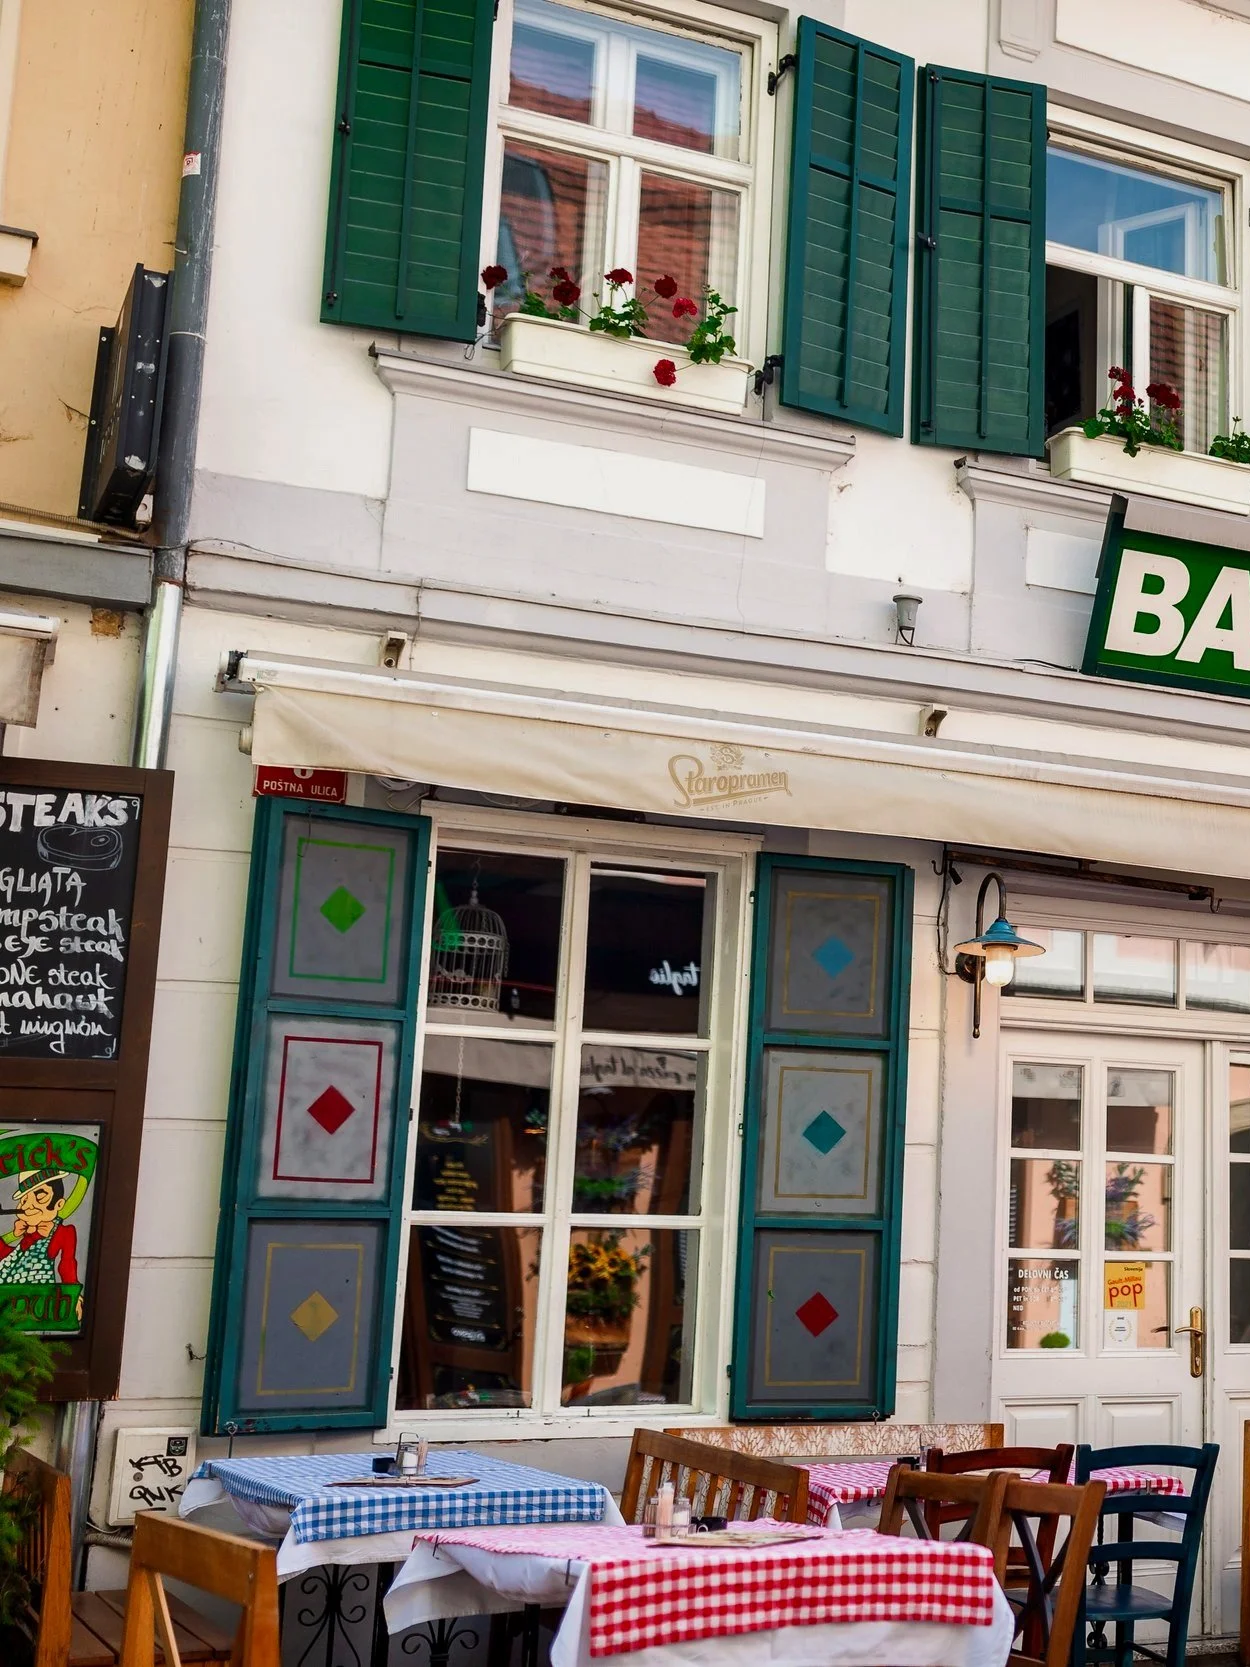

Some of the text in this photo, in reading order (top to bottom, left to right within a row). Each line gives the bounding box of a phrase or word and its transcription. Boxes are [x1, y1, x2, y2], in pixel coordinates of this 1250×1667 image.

[263, 779, 337, 797] POŠTNA ULICA
[668, 754, 790, 809] Staropramen
[0, 791, 129, 832] TEAKS
[48, 963, 116, 990] steak
[1018, 1267, 1069, 1280] DELOVNI ČAS
[1109, 1283, 1143, 1308] pop
